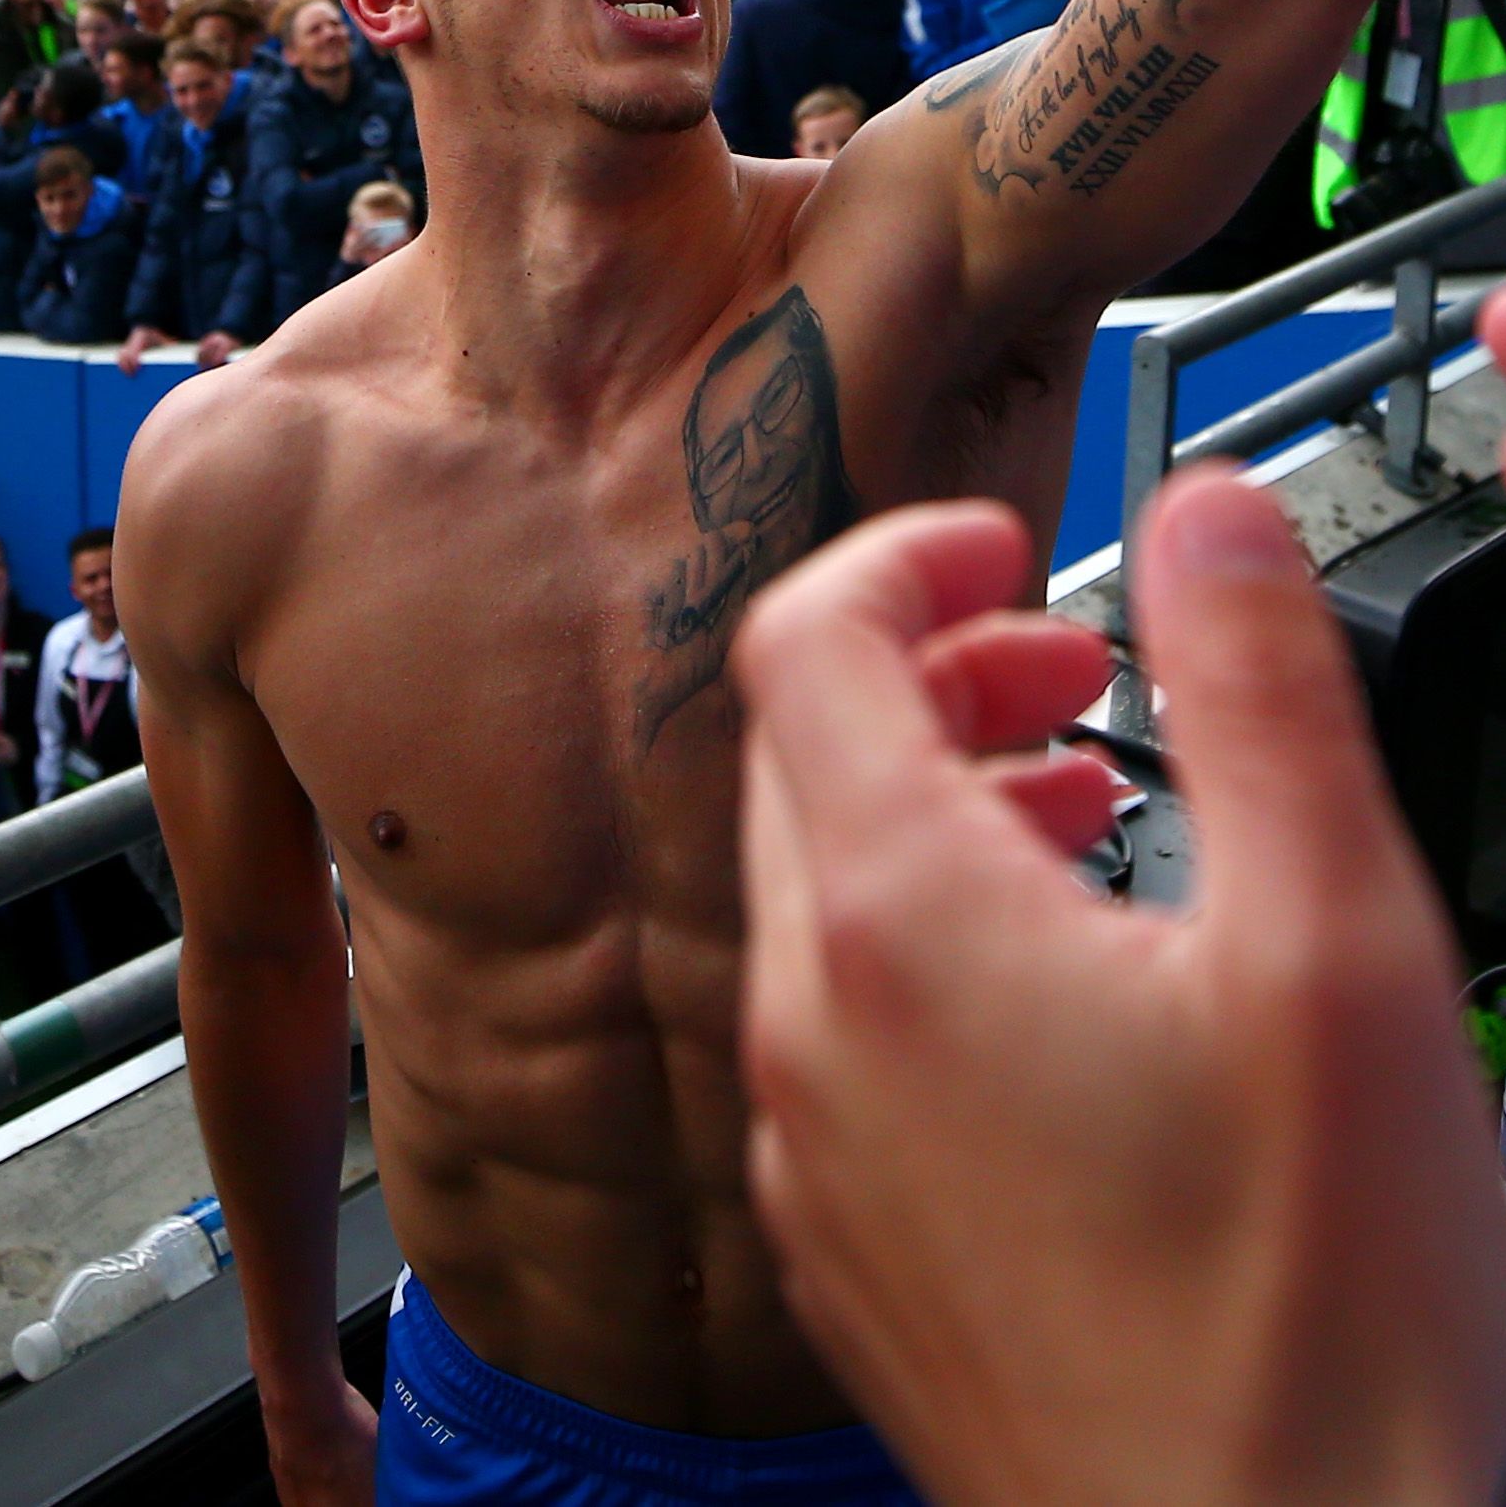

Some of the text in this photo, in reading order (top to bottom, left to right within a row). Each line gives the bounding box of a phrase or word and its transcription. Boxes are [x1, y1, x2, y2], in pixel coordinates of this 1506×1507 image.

[1055, 70, 1077, 100] love
[1077, 44, 1095, 96] of
[394, 1378, 455, 1444] DRI-FIT
